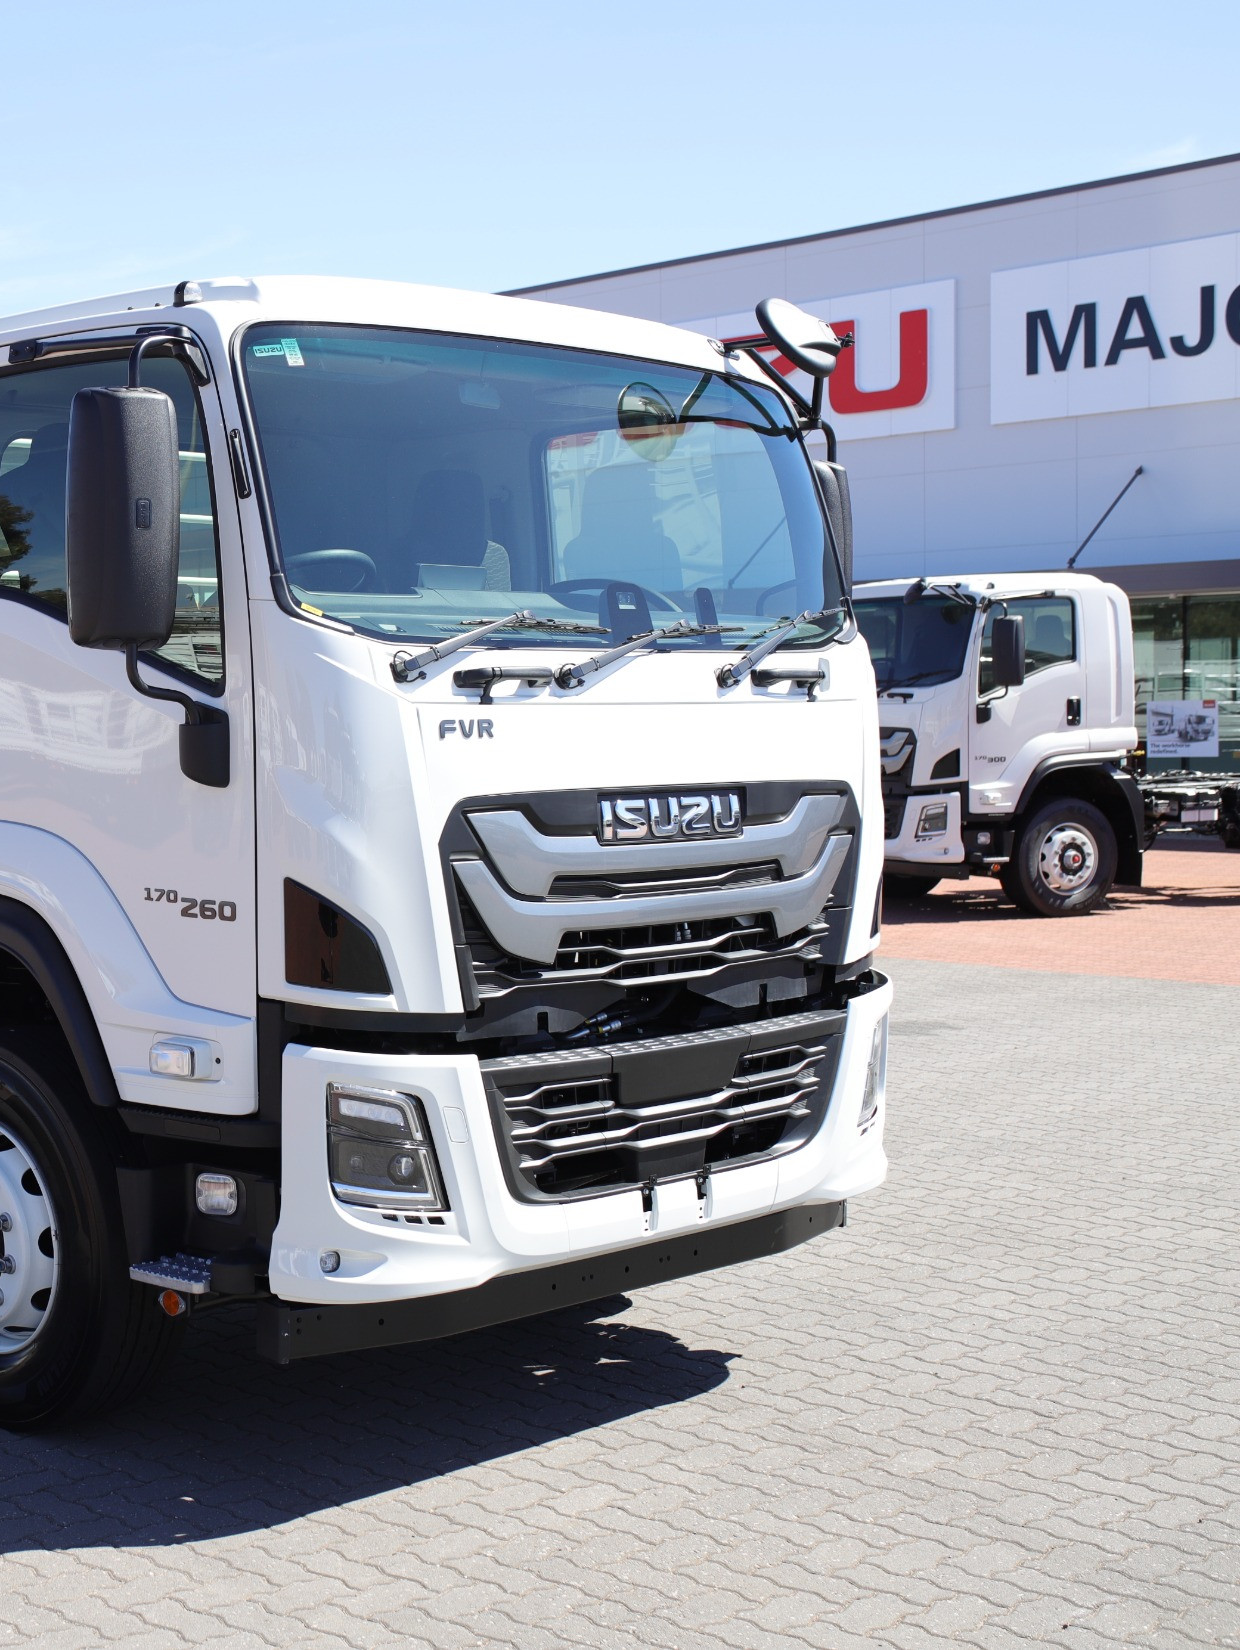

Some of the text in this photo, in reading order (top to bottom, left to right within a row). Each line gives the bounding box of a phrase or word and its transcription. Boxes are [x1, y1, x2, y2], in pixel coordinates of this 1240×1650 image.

[1026, 284, 1240, 376] MAJ
[254, 346, 282, 354] ISUZU
[438, 719, 494, 740] FVR
[601, 793, 740, 840] ISUZU
[144, 887, 237, 922] 170 260
